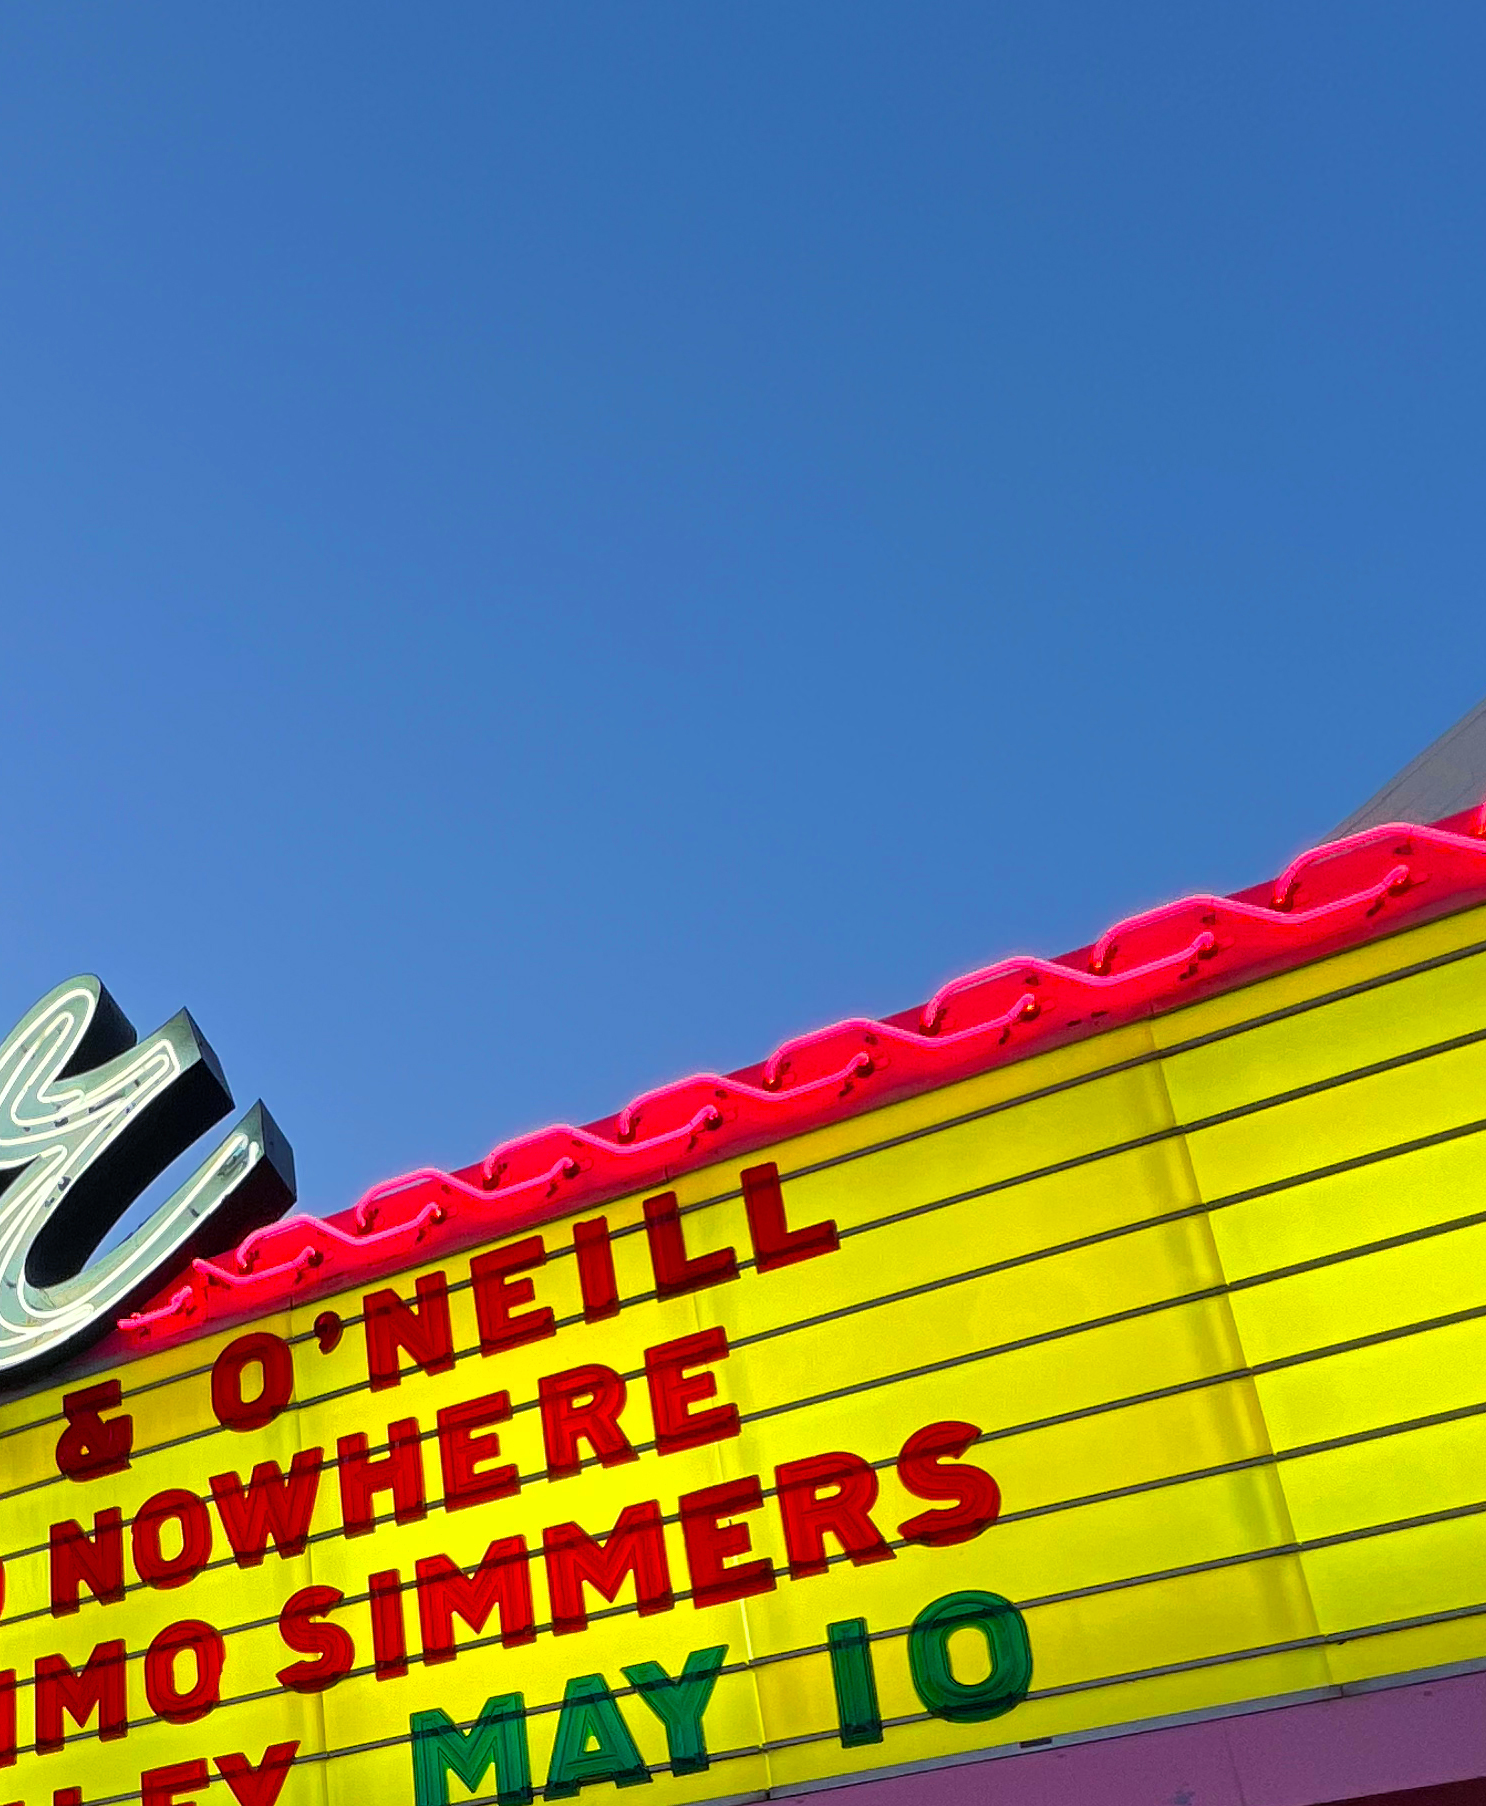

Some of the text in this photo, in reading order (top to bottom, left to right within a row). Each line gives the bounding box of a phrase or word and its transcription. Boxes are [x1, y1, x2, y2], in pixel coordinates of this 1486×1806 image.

[49, 1325, 741, 1618] NOWHERE
[55, 1378, 135, 1483] &
[276, 1420, 1003, 1693] SIMMERS
[827, 1589, 1034, 1748] 10
